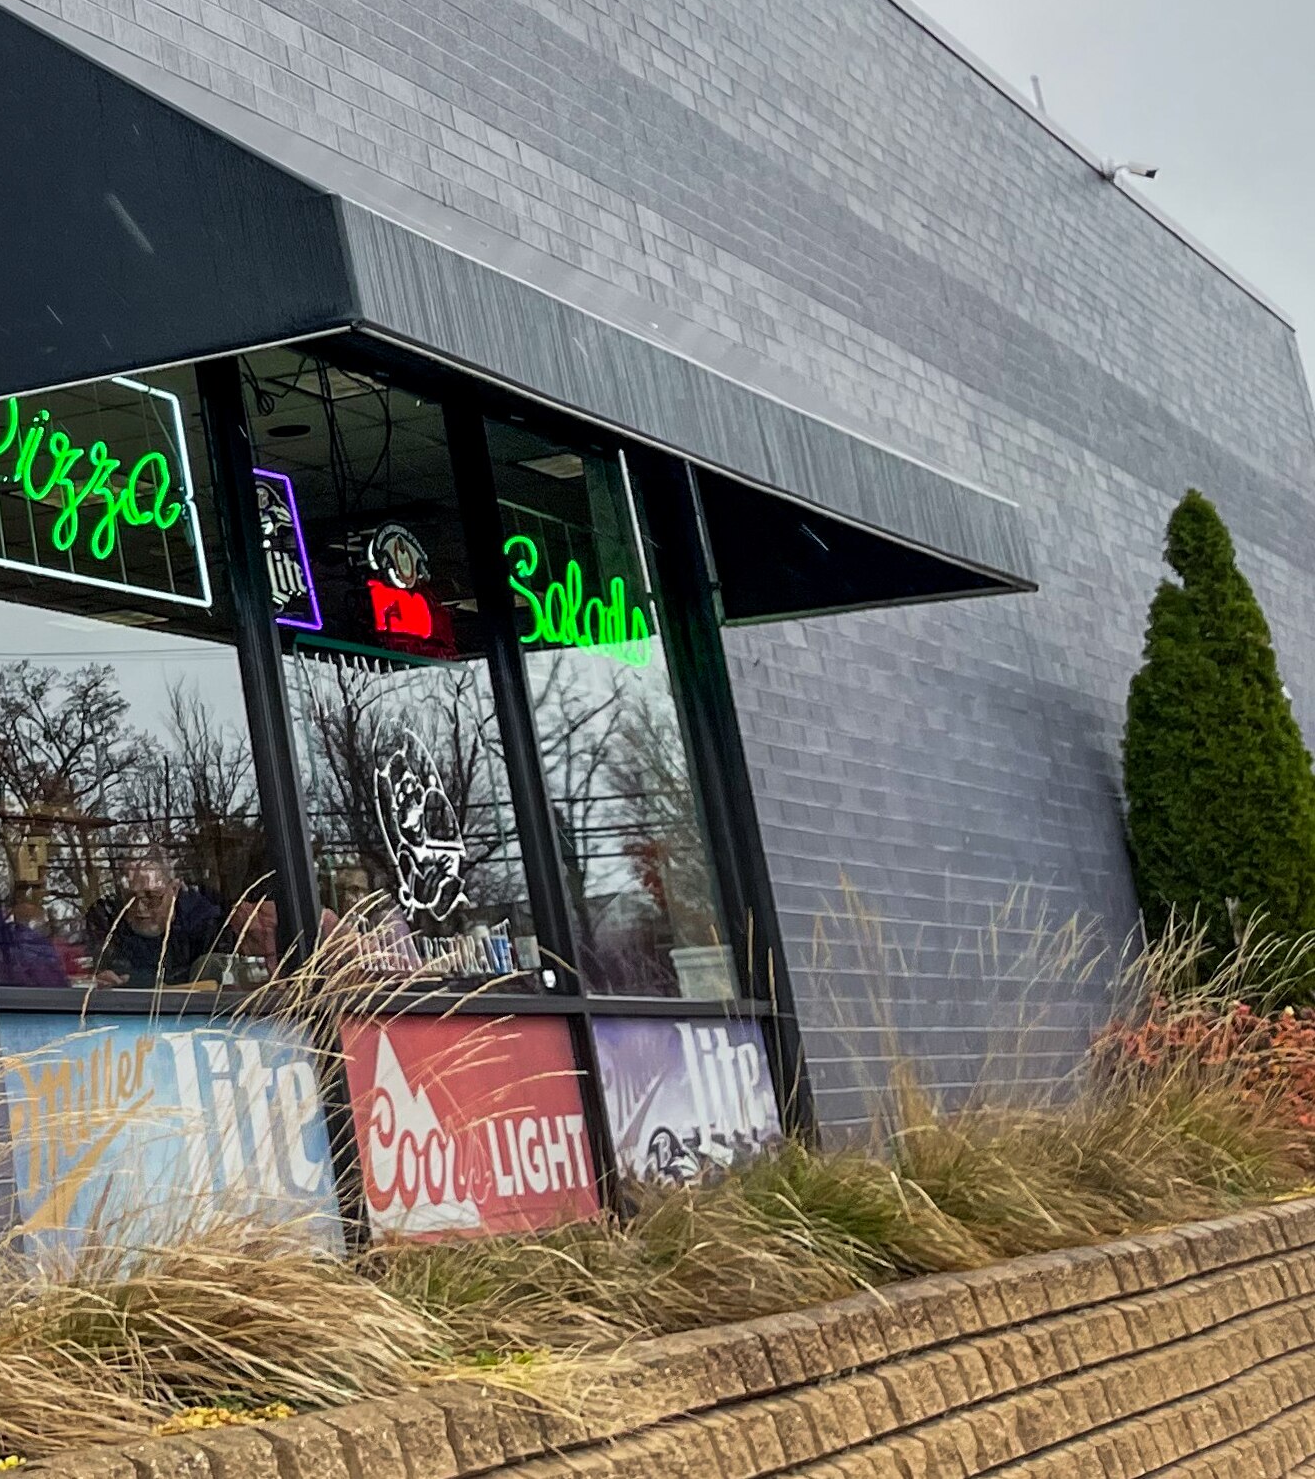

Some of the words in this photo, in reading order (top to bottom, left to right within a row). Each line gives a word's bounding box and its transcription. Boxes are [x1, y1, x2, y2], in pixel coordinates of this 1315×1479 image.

[503, 535, 653, 668] Salads
[8, 1033, 156, 1204] Miller
[162, 1032, 326, 1207] lite
[486, 1114, 589, 1198] LIGHT
